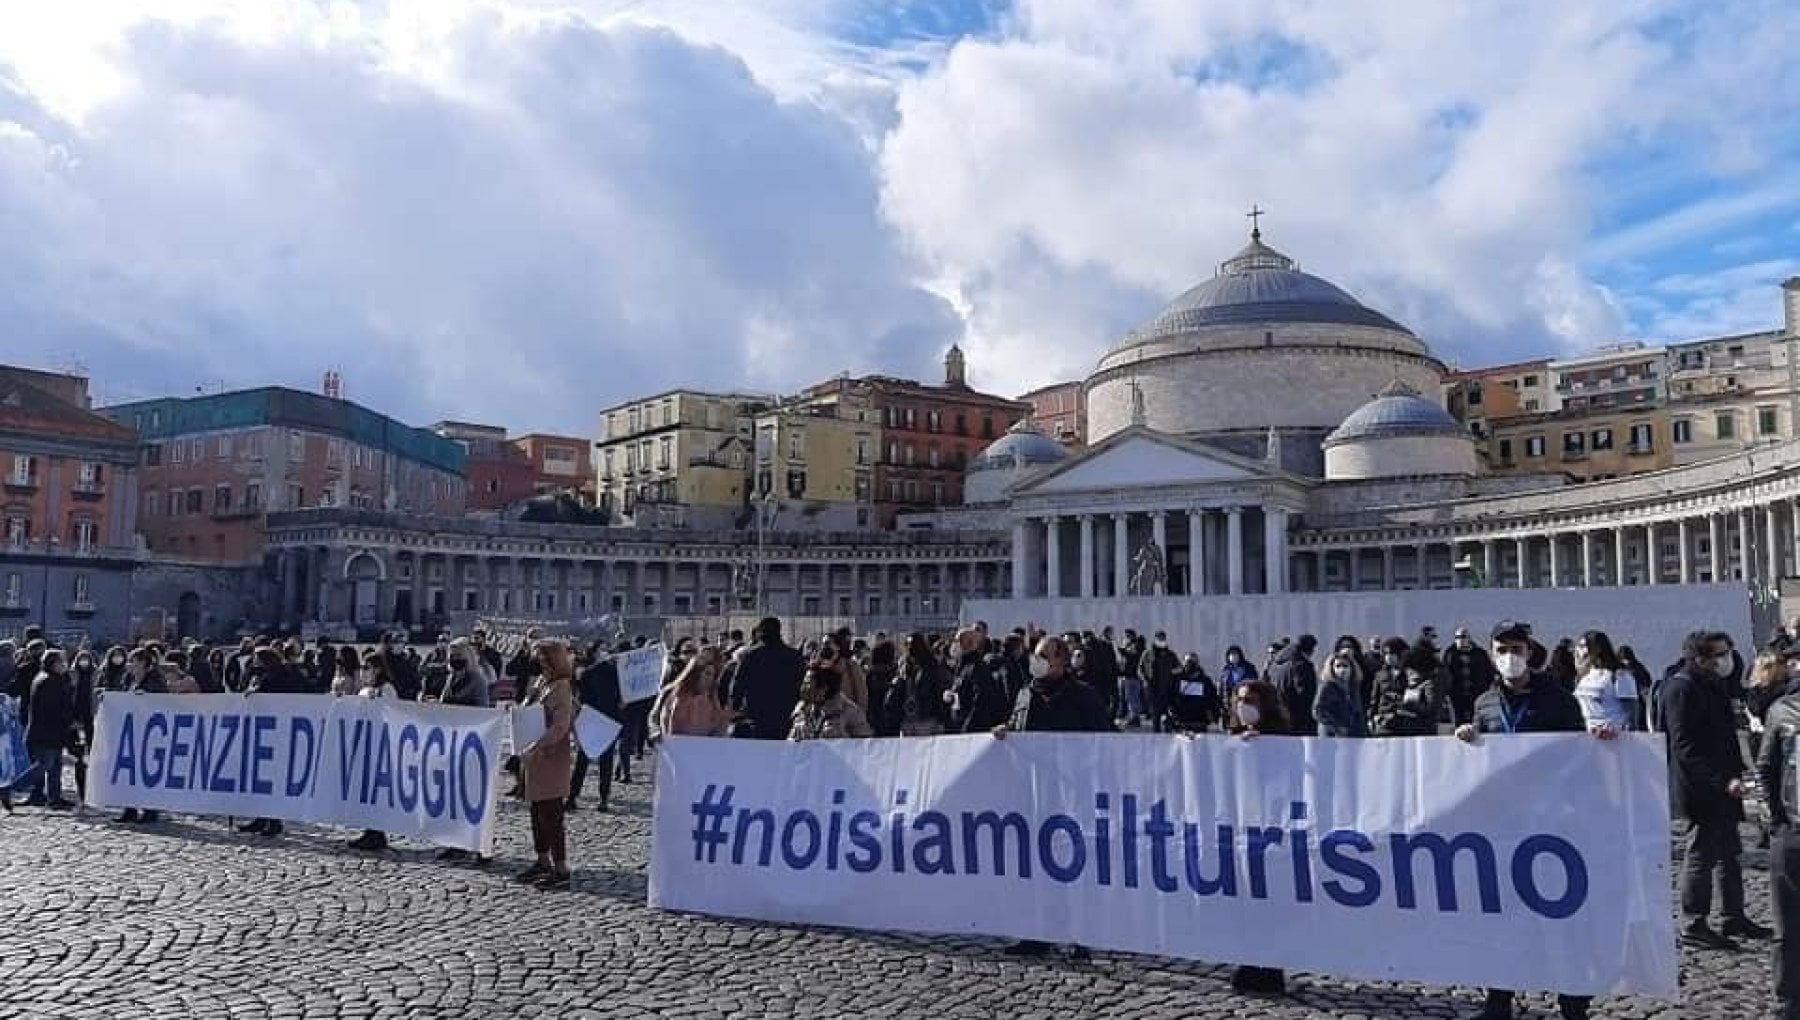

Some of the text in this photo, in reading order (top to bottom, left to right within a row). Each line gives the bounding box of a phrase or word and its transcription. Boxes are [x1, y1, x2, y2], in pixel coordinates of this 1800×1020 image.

[111, 712, 489, 825] AGENZIE DI VIAGGIO
[691, 784, 1590, 920] #noisiamoilturismo
